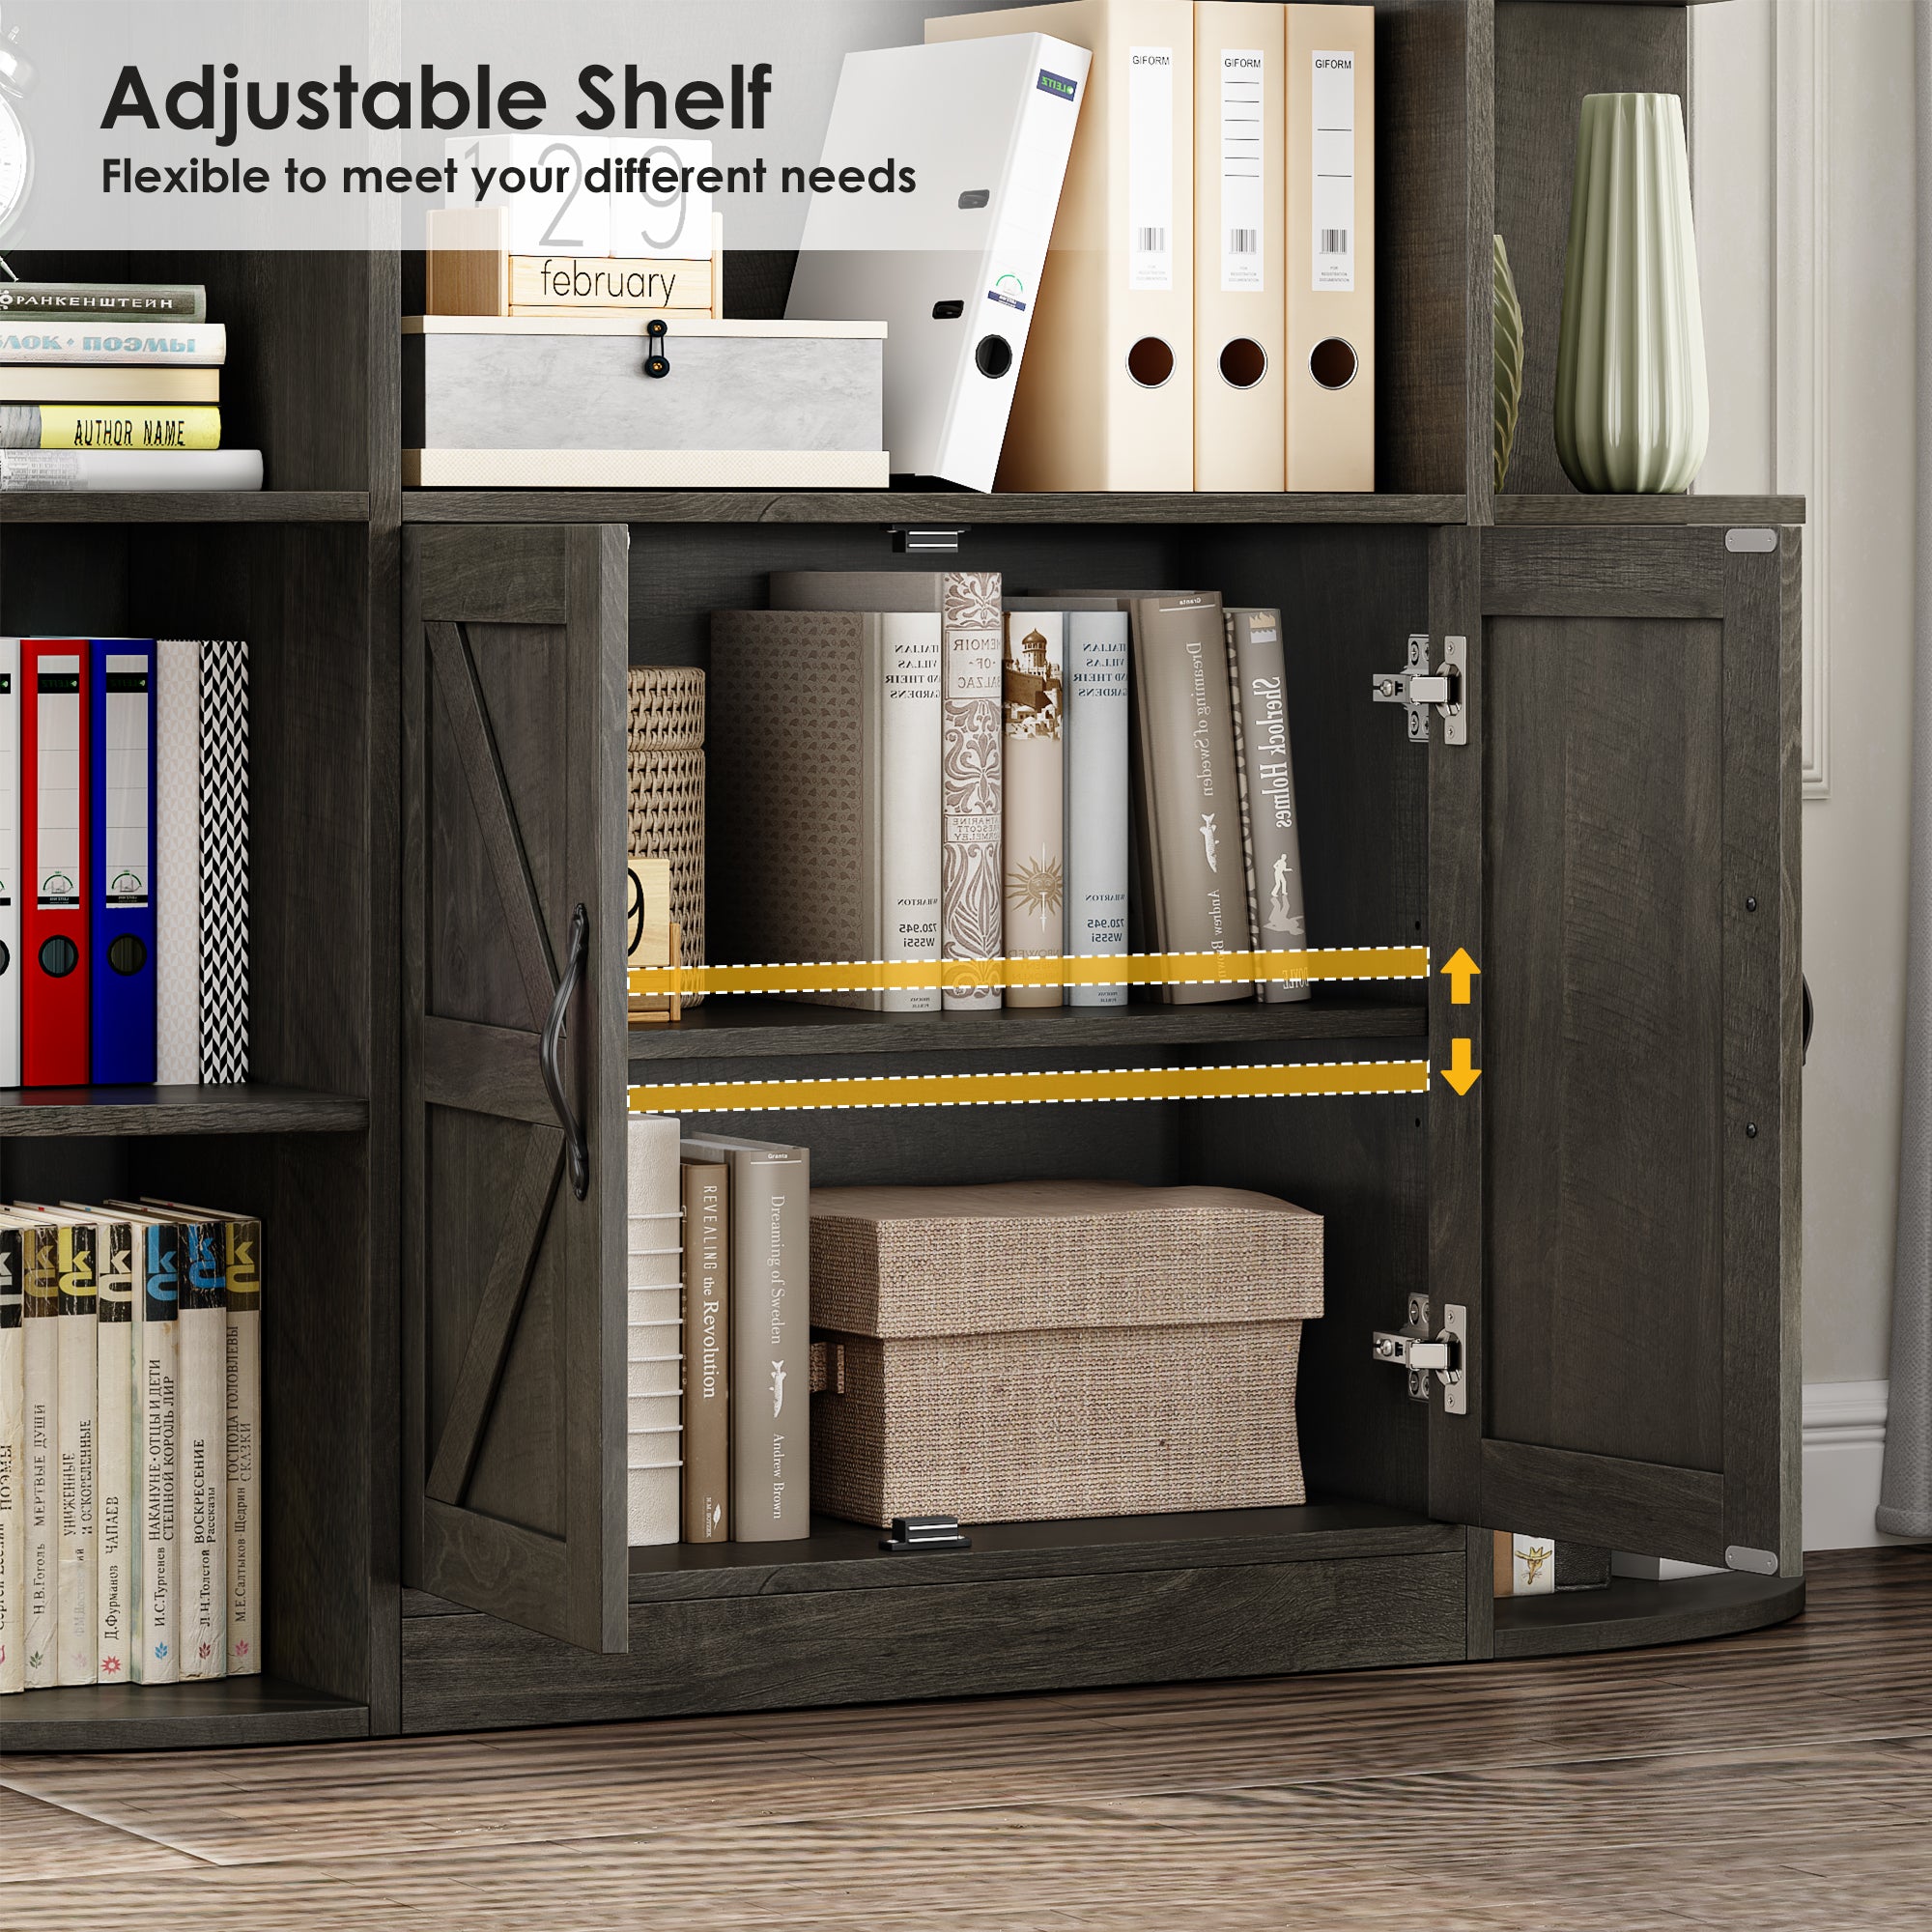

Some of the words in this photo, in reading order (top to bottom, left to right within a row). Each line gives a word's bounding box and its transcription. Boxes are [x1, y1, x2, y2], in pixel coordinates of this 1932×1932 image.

[1132, 54, 1170, 66] GIFORM
[1224, 58, 1262, 69] GIFORM
[1315, 59, 1352, 70] GIFORM
[540, 259, 676, 308] february
[0, 335, 63, 350] ЛОК
[82, 336, 195, 353] ПОЭМЫ
[74, 419, 133, 446] AUTHOR
[143, 419, 186, 446] NAME
[702, 1185, 718, 1270] REVEALING
[767, 1194, 785, 1267] Dreaming
[703, 1276, 715, 1295] the
[771, 1270, 785, 1286] of
[771, 1288, 785, 1345] Sweden
[149, 1359, 162, 1397] ДЕТИ
[226, 1325, 240, 1410] ГОЛОВЛЕВЫ
[702, 1300, 720, 1399] Revolution
[149, 1400, 160, 1409] И
[162, 1376, 174, 1406] ЛИР
[148, 1413, 162, 1456] ОТЦЫ
[162, 1410, 174, 1465] КОРОЛЬ
[226, 1414, 240, 1482] ГОСПОДА
[240, 1422, 251, 1482] СКАЗКИ
[772, 1433, 784, 1477] Andrew
[33, 1456, 45, 1526] МЕРТВЫЕ
[62, 1453, 76, 1537] УНИЖЕННЫЕ
[148, 1463, 160, 1541] НАКАНУНЕ
[161, 1471, 174, 1542] СТЕПНОЙ
[193, 1438, 205, 1544] ВОСКРЕСЕНИЕ
[206, 1487, 215, 1544] Рассказы
[772, 1482, 784, 1520] Brown
[105, 1496, 119, 1554] ЧАПАЕВ
[33, 1543, 45, 1615] Н.В.Гоголь
[104, 1565, 120, 1640] Д.Фурманов
[154, 1547, 168, 1628] И.С.Тургенев
